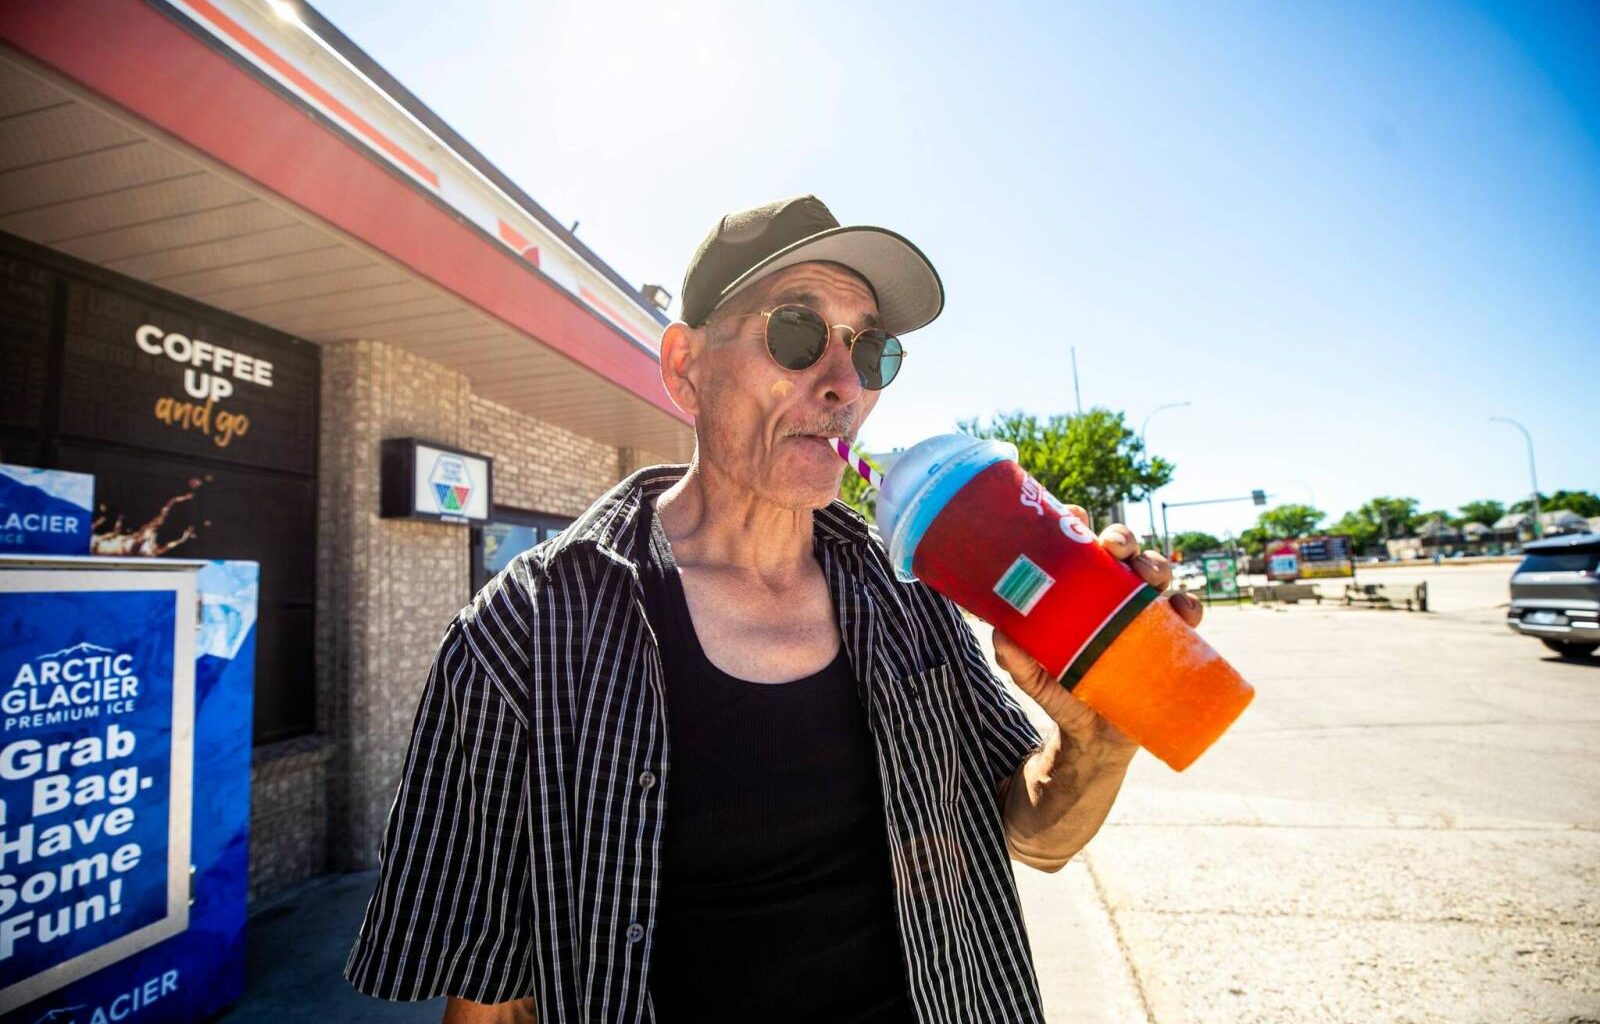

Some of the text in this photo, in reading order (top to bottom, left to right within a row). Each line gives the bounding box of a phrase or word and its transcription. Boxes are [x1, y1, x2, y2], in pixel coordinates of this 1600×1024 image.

[135, 324, 274, 387] COFFEE
[184, 368, 234, 402] UP
[154, 397, 249, 447] and go
[1, 675, 139, 714] GLACIER
[12, 653, 134, 688] ARCTIC
[5, 700, 135, 731] PREMIUM ICE
[0, 724, 136, 780] Grab
[32, 766, 153, 817] Bag.
[0, 806, 135, 870] Have
[0, 843, 142, 915] Some
[0, 878, 123, 961] Fun!
[69, 969, 179, 1024] ACIER
